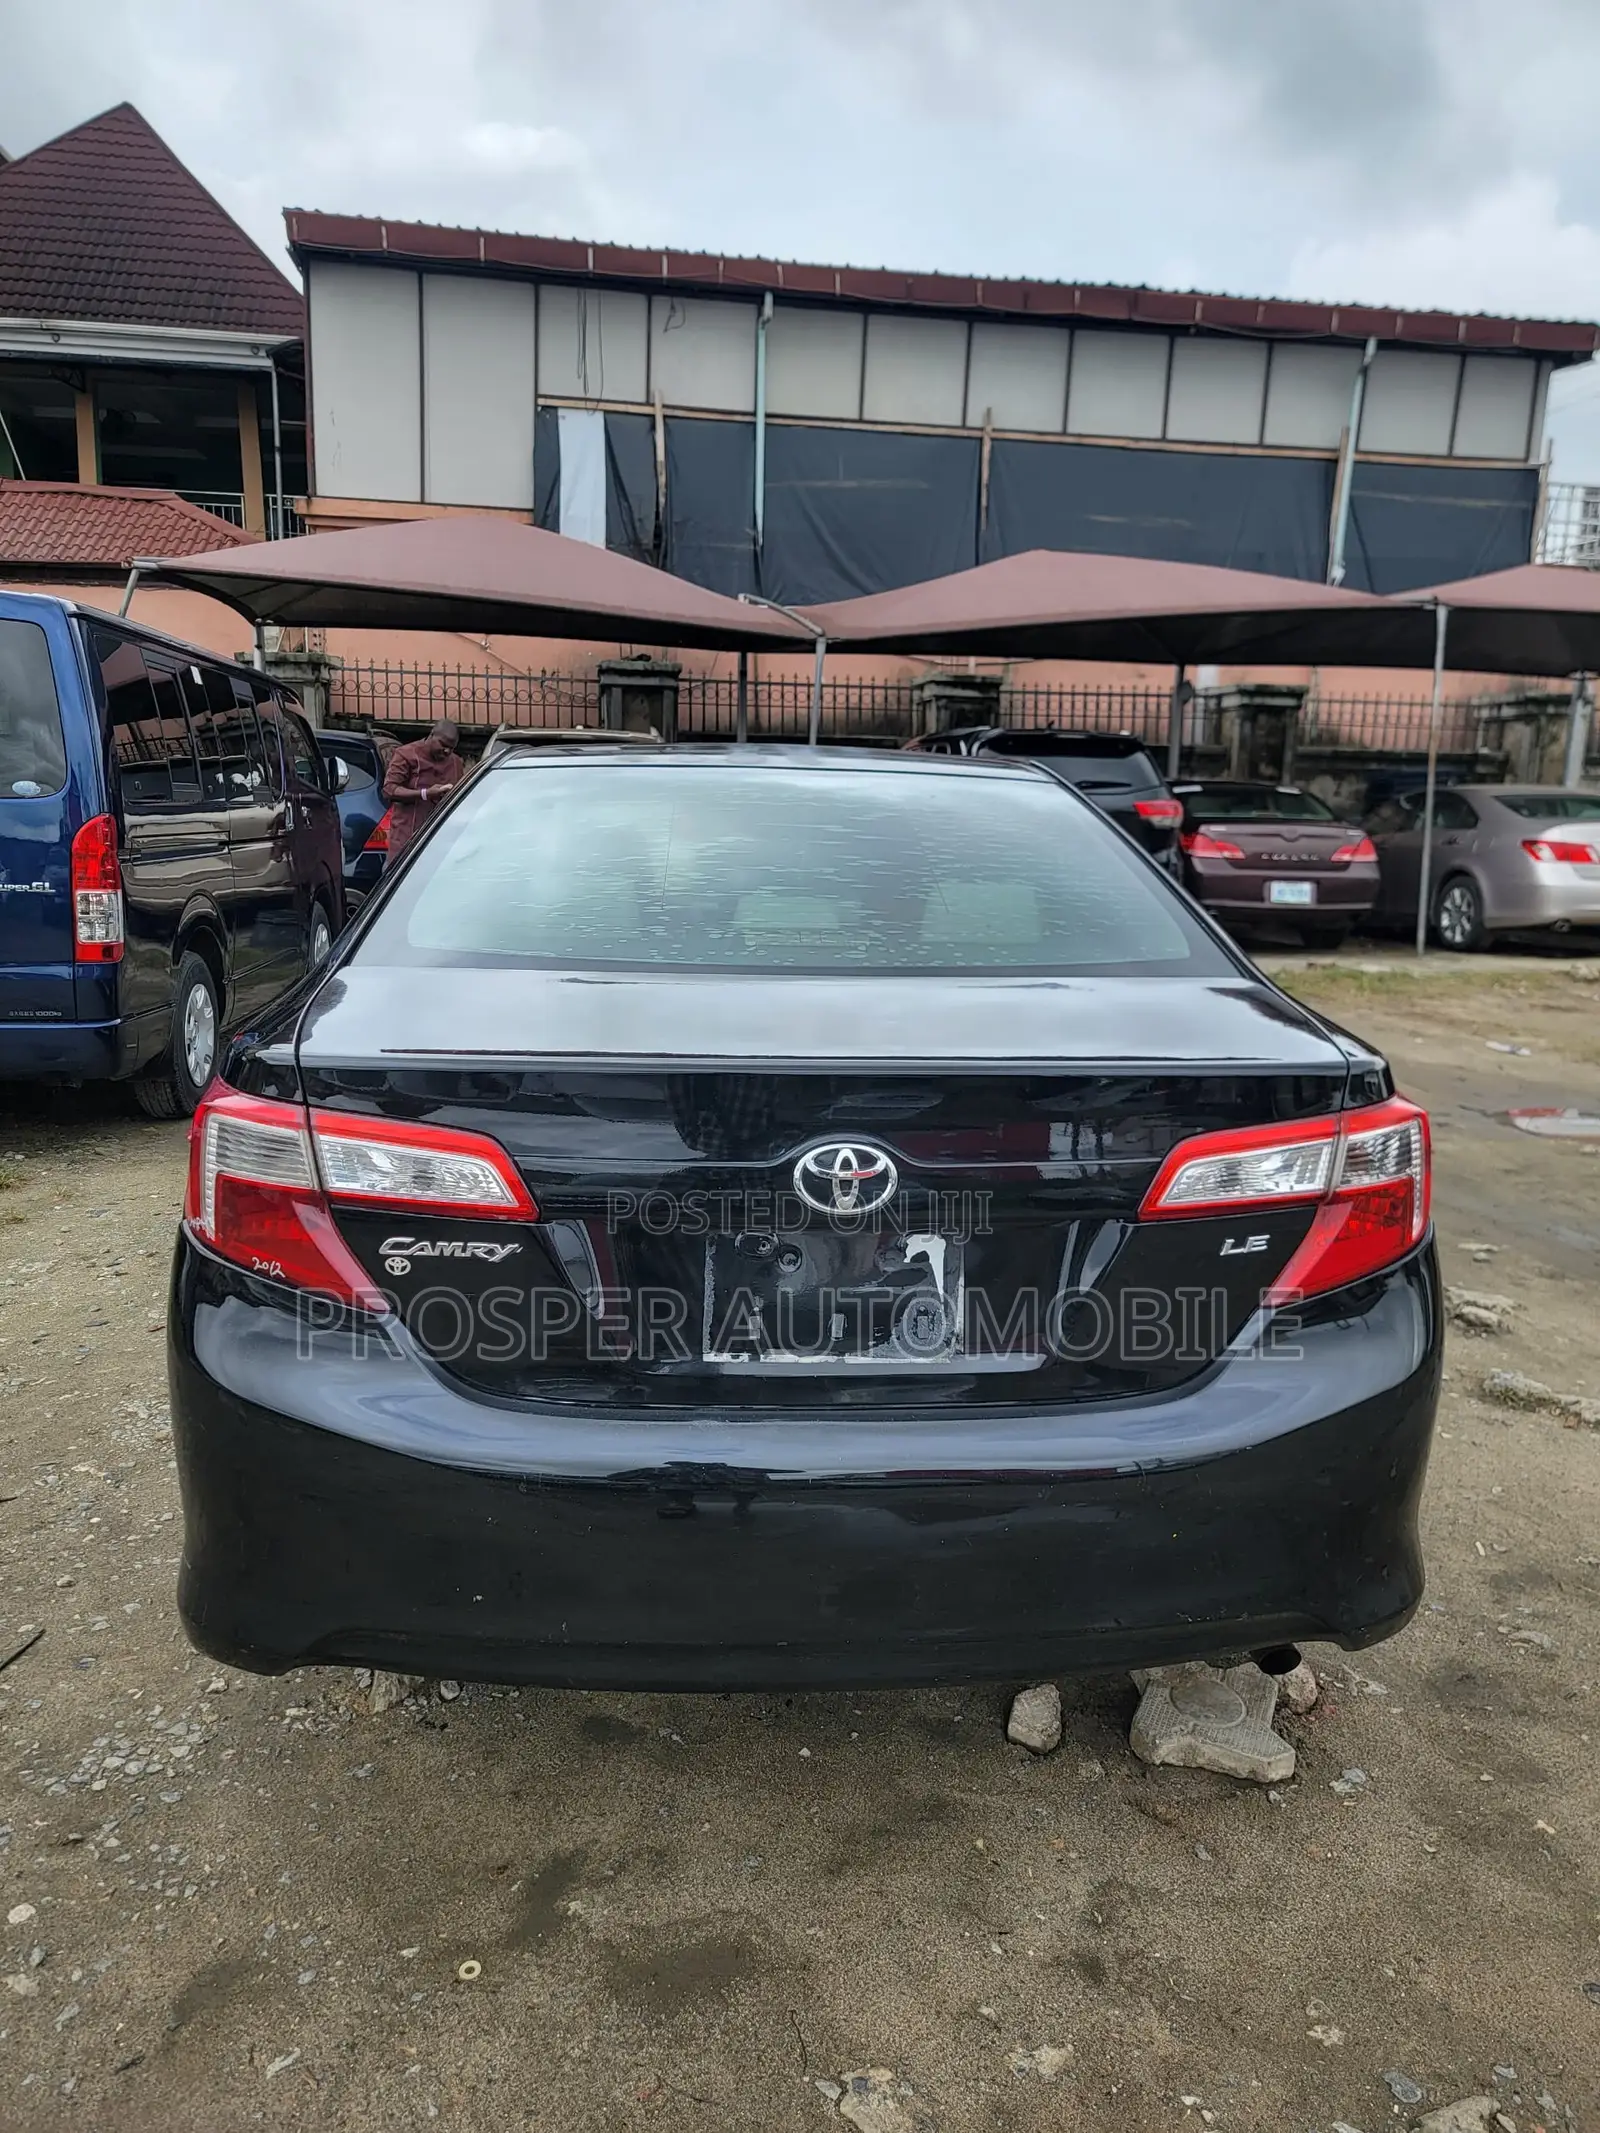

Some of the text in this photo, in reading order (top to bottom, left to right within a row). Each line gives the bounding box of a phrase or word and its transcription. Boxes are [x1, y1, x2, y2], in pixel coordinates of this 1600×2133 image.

[378, 1237, 523, 1263] CAMRY
[1219, 1234, 1271, 1256] LE
[251, 1256, 286, 1279] 2012
